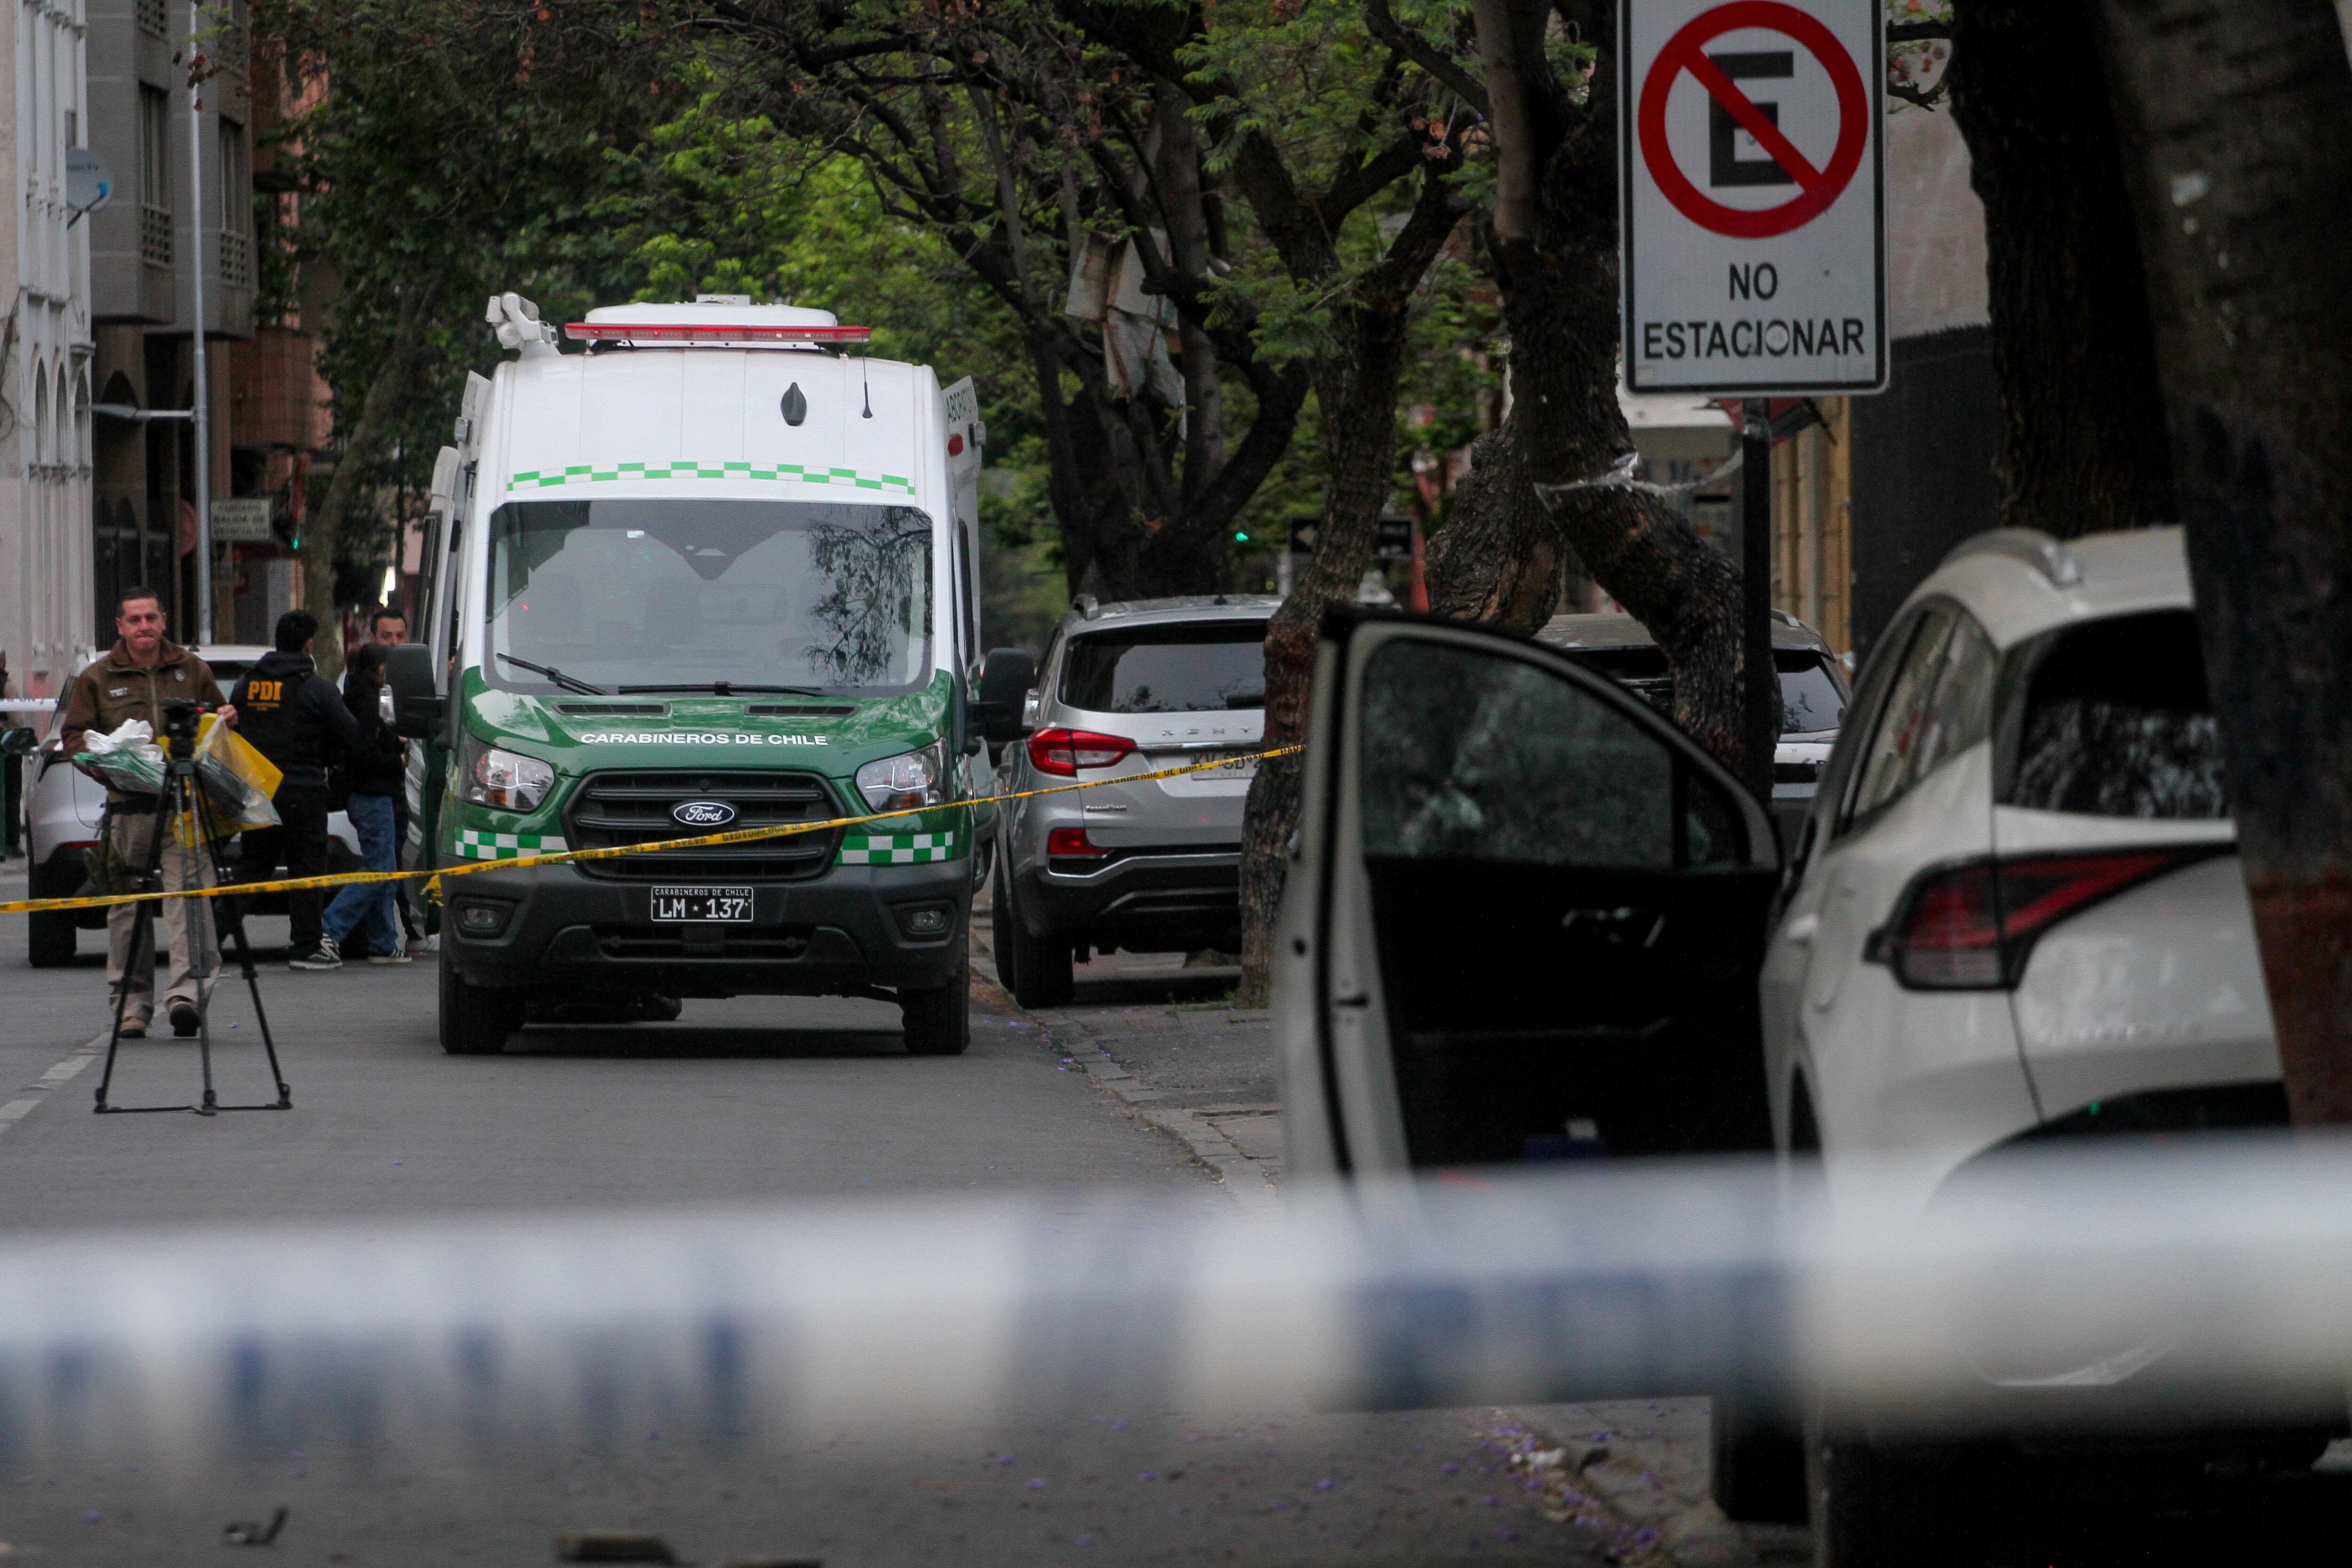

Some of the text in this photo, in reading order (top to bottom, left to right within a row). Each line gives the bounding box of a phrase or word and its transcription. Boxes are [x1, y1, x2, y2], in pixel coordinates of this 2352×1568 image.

[1709, 52, 1794, 187] E
[1729, 262, 1778, 301] NO
[1644, 317, 1865, 359] ESTACIONAR
[247, 680, 283, 700] PDI
[581, 733, 828, 746] CARABINEROS DE CHILE
[685, 805, 723, 821] Ford
[660, 898, 744, 918] LM 137
